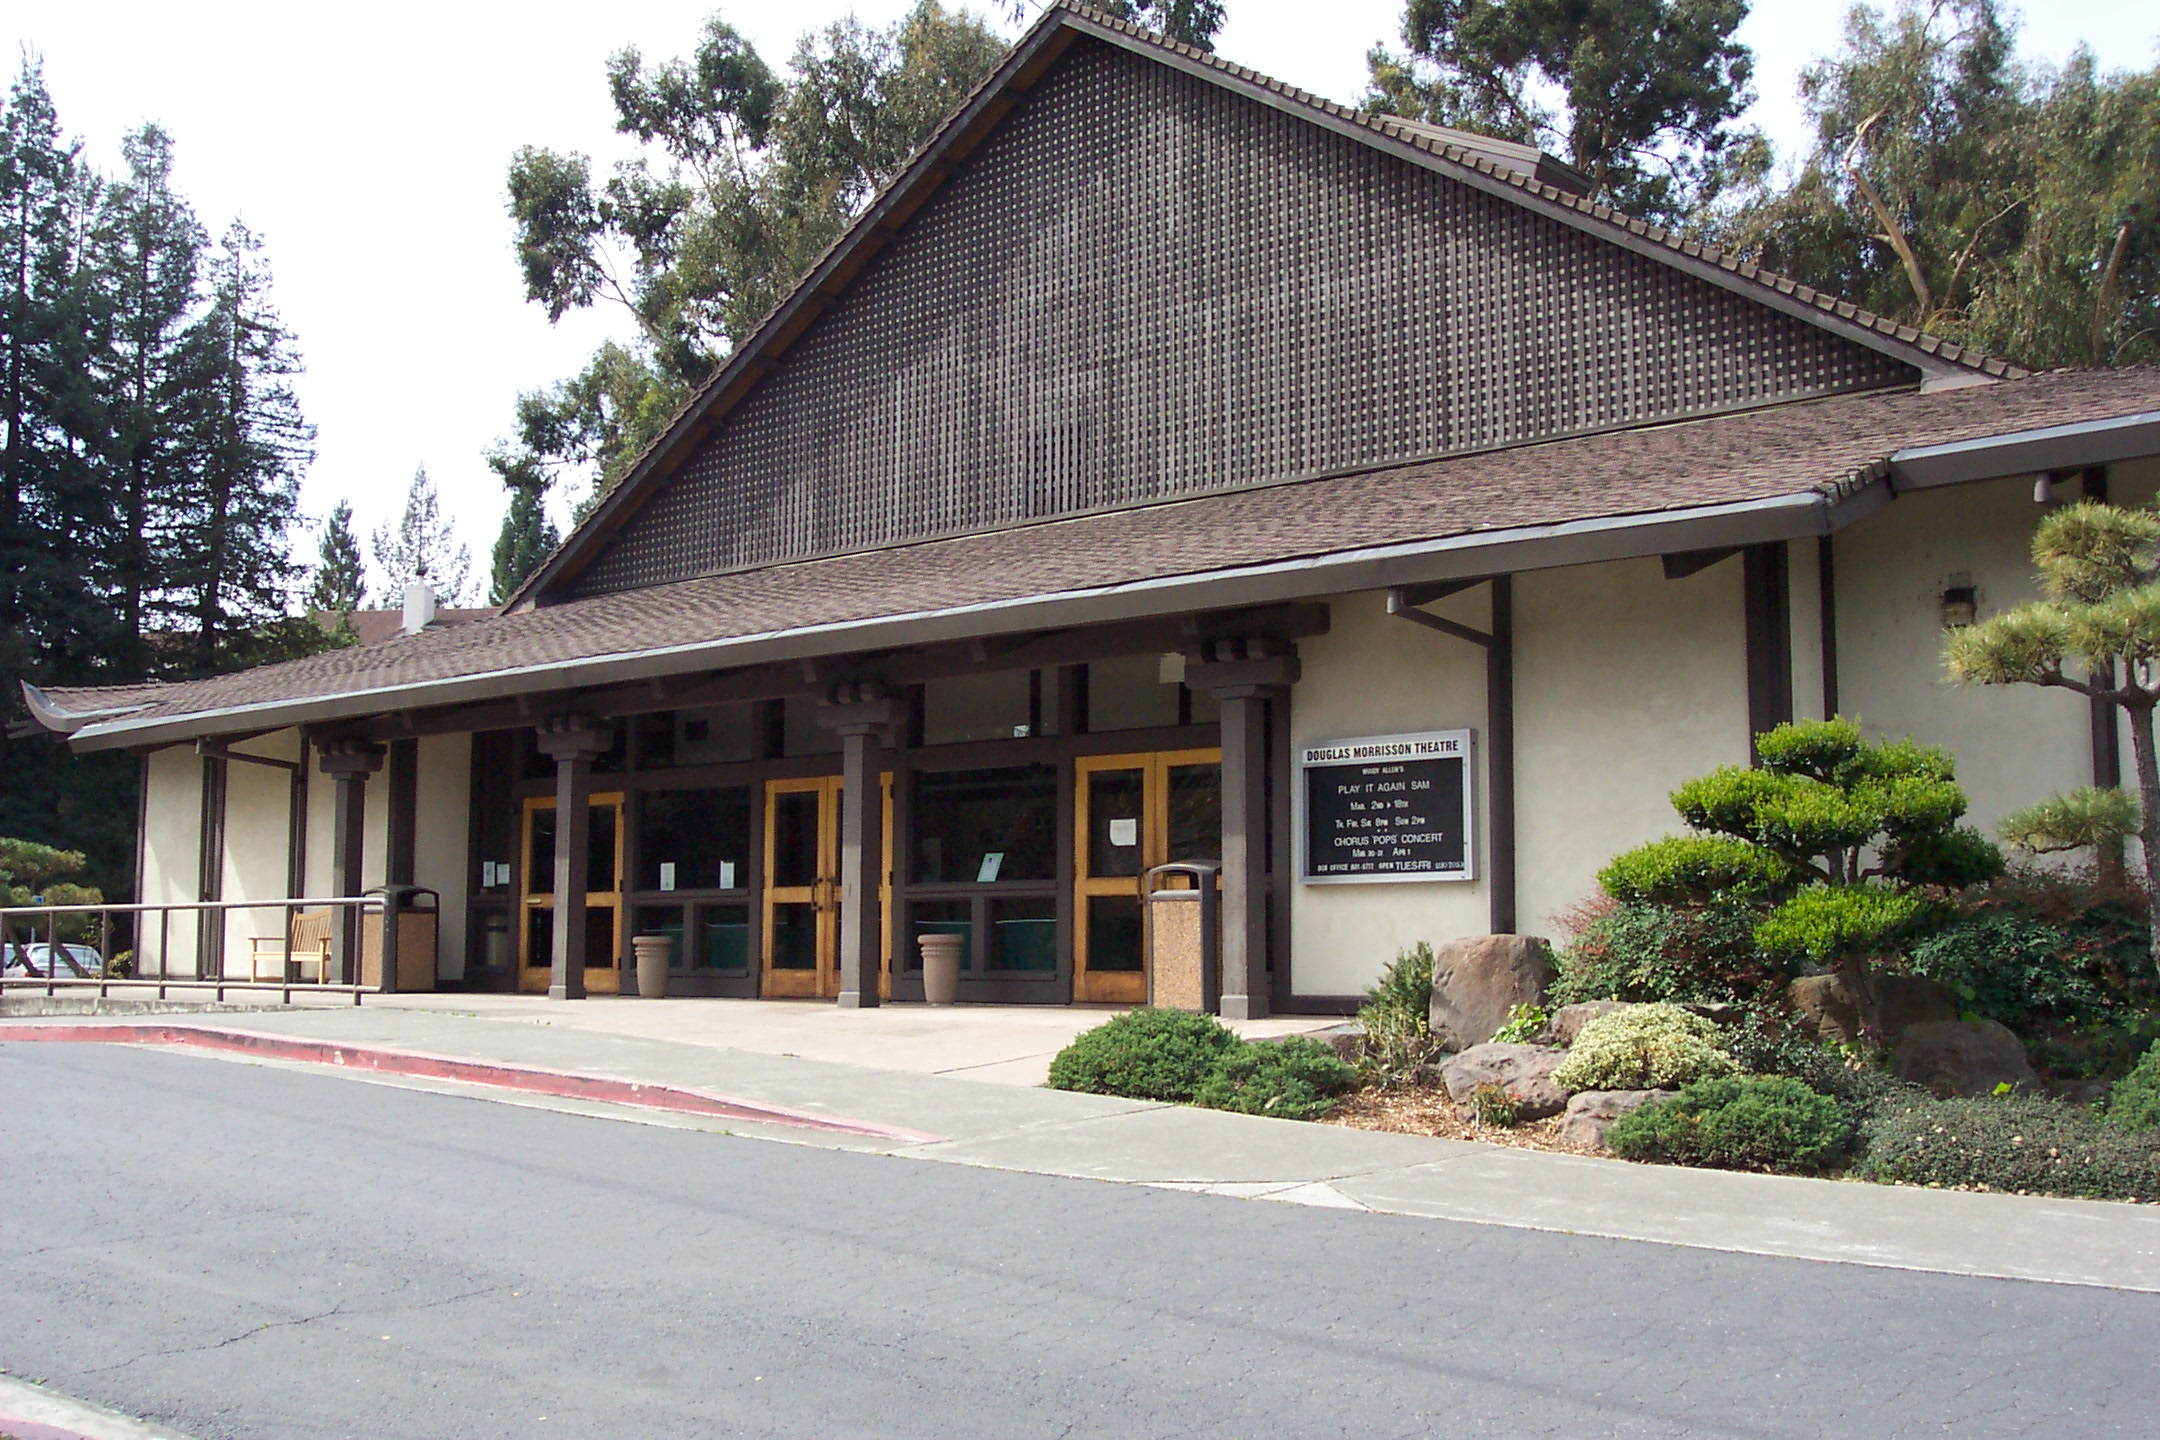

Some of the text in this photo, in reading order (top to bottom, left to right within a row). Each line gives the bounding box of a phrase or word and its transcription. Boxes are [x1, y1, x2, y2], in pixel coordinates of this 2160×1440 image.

[1307, 740, 1459, 761] DOUGLAS MORRISSON THEATRE
[1338, 780, 1430, 795] PLAY IT AGAIN SAM
[1334, 836, 1369, 847] CHORUS
[1401, 832, 1443, 844] CONCERT
